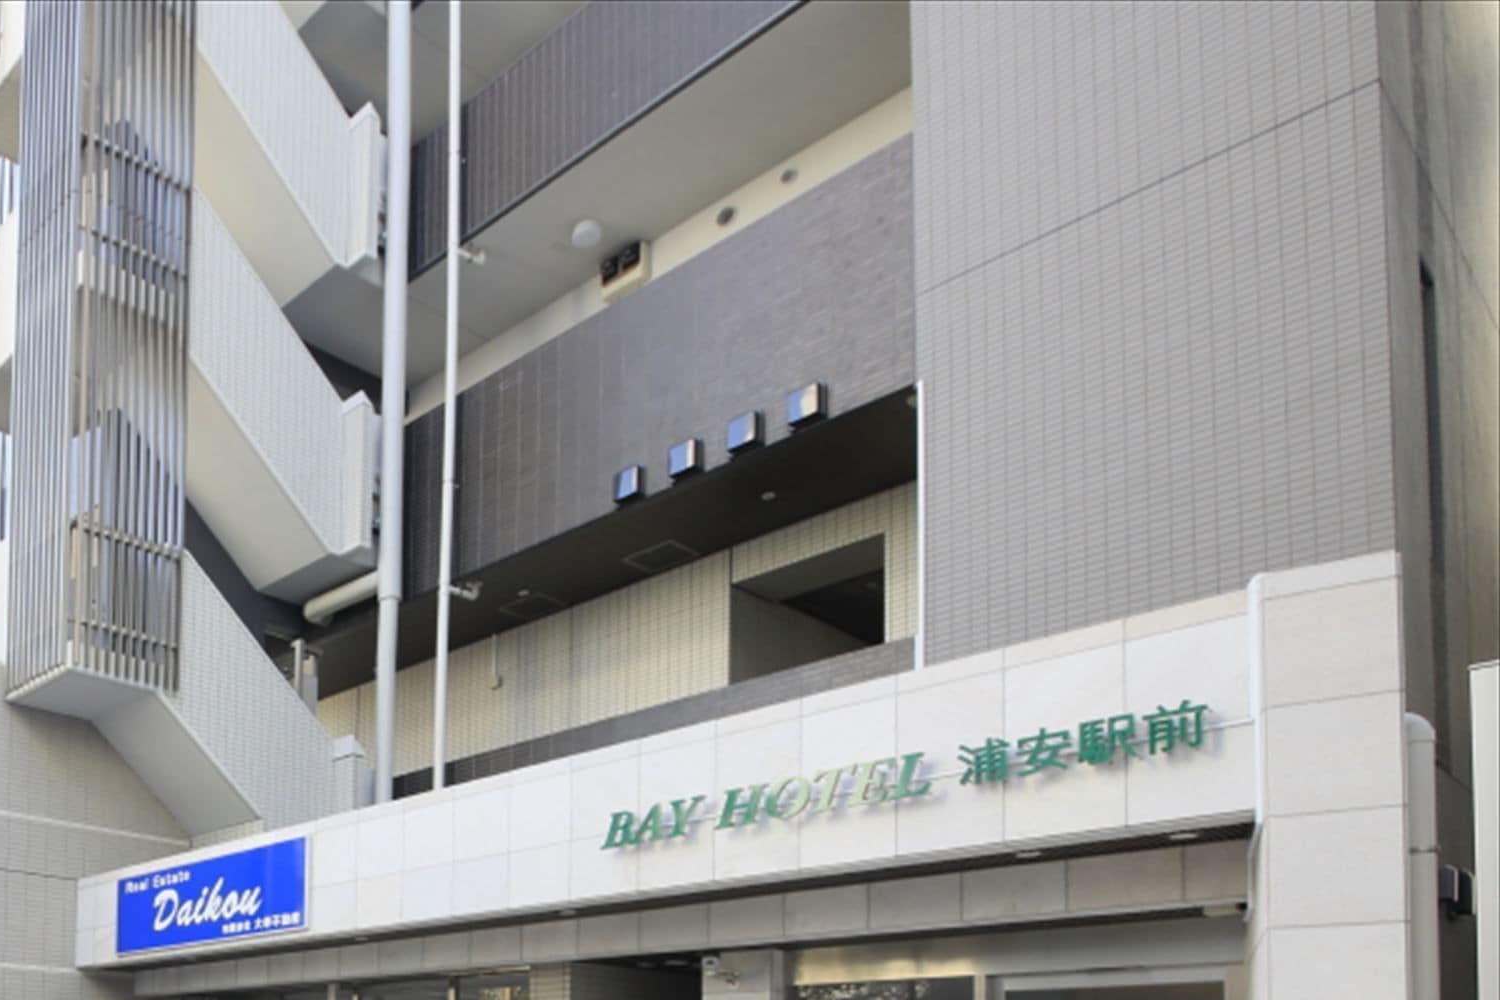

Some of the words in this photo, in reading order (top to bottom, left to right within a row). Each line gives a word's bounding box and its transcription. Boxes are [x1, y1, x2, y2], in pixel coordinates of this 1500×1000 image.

[600, 794, 706, 850] BAY
[713, 752, 932, 831] HOTEL
[957, 699, 1209, 785] 浦安駅前
[154, 877, 262, 931] Daikou
